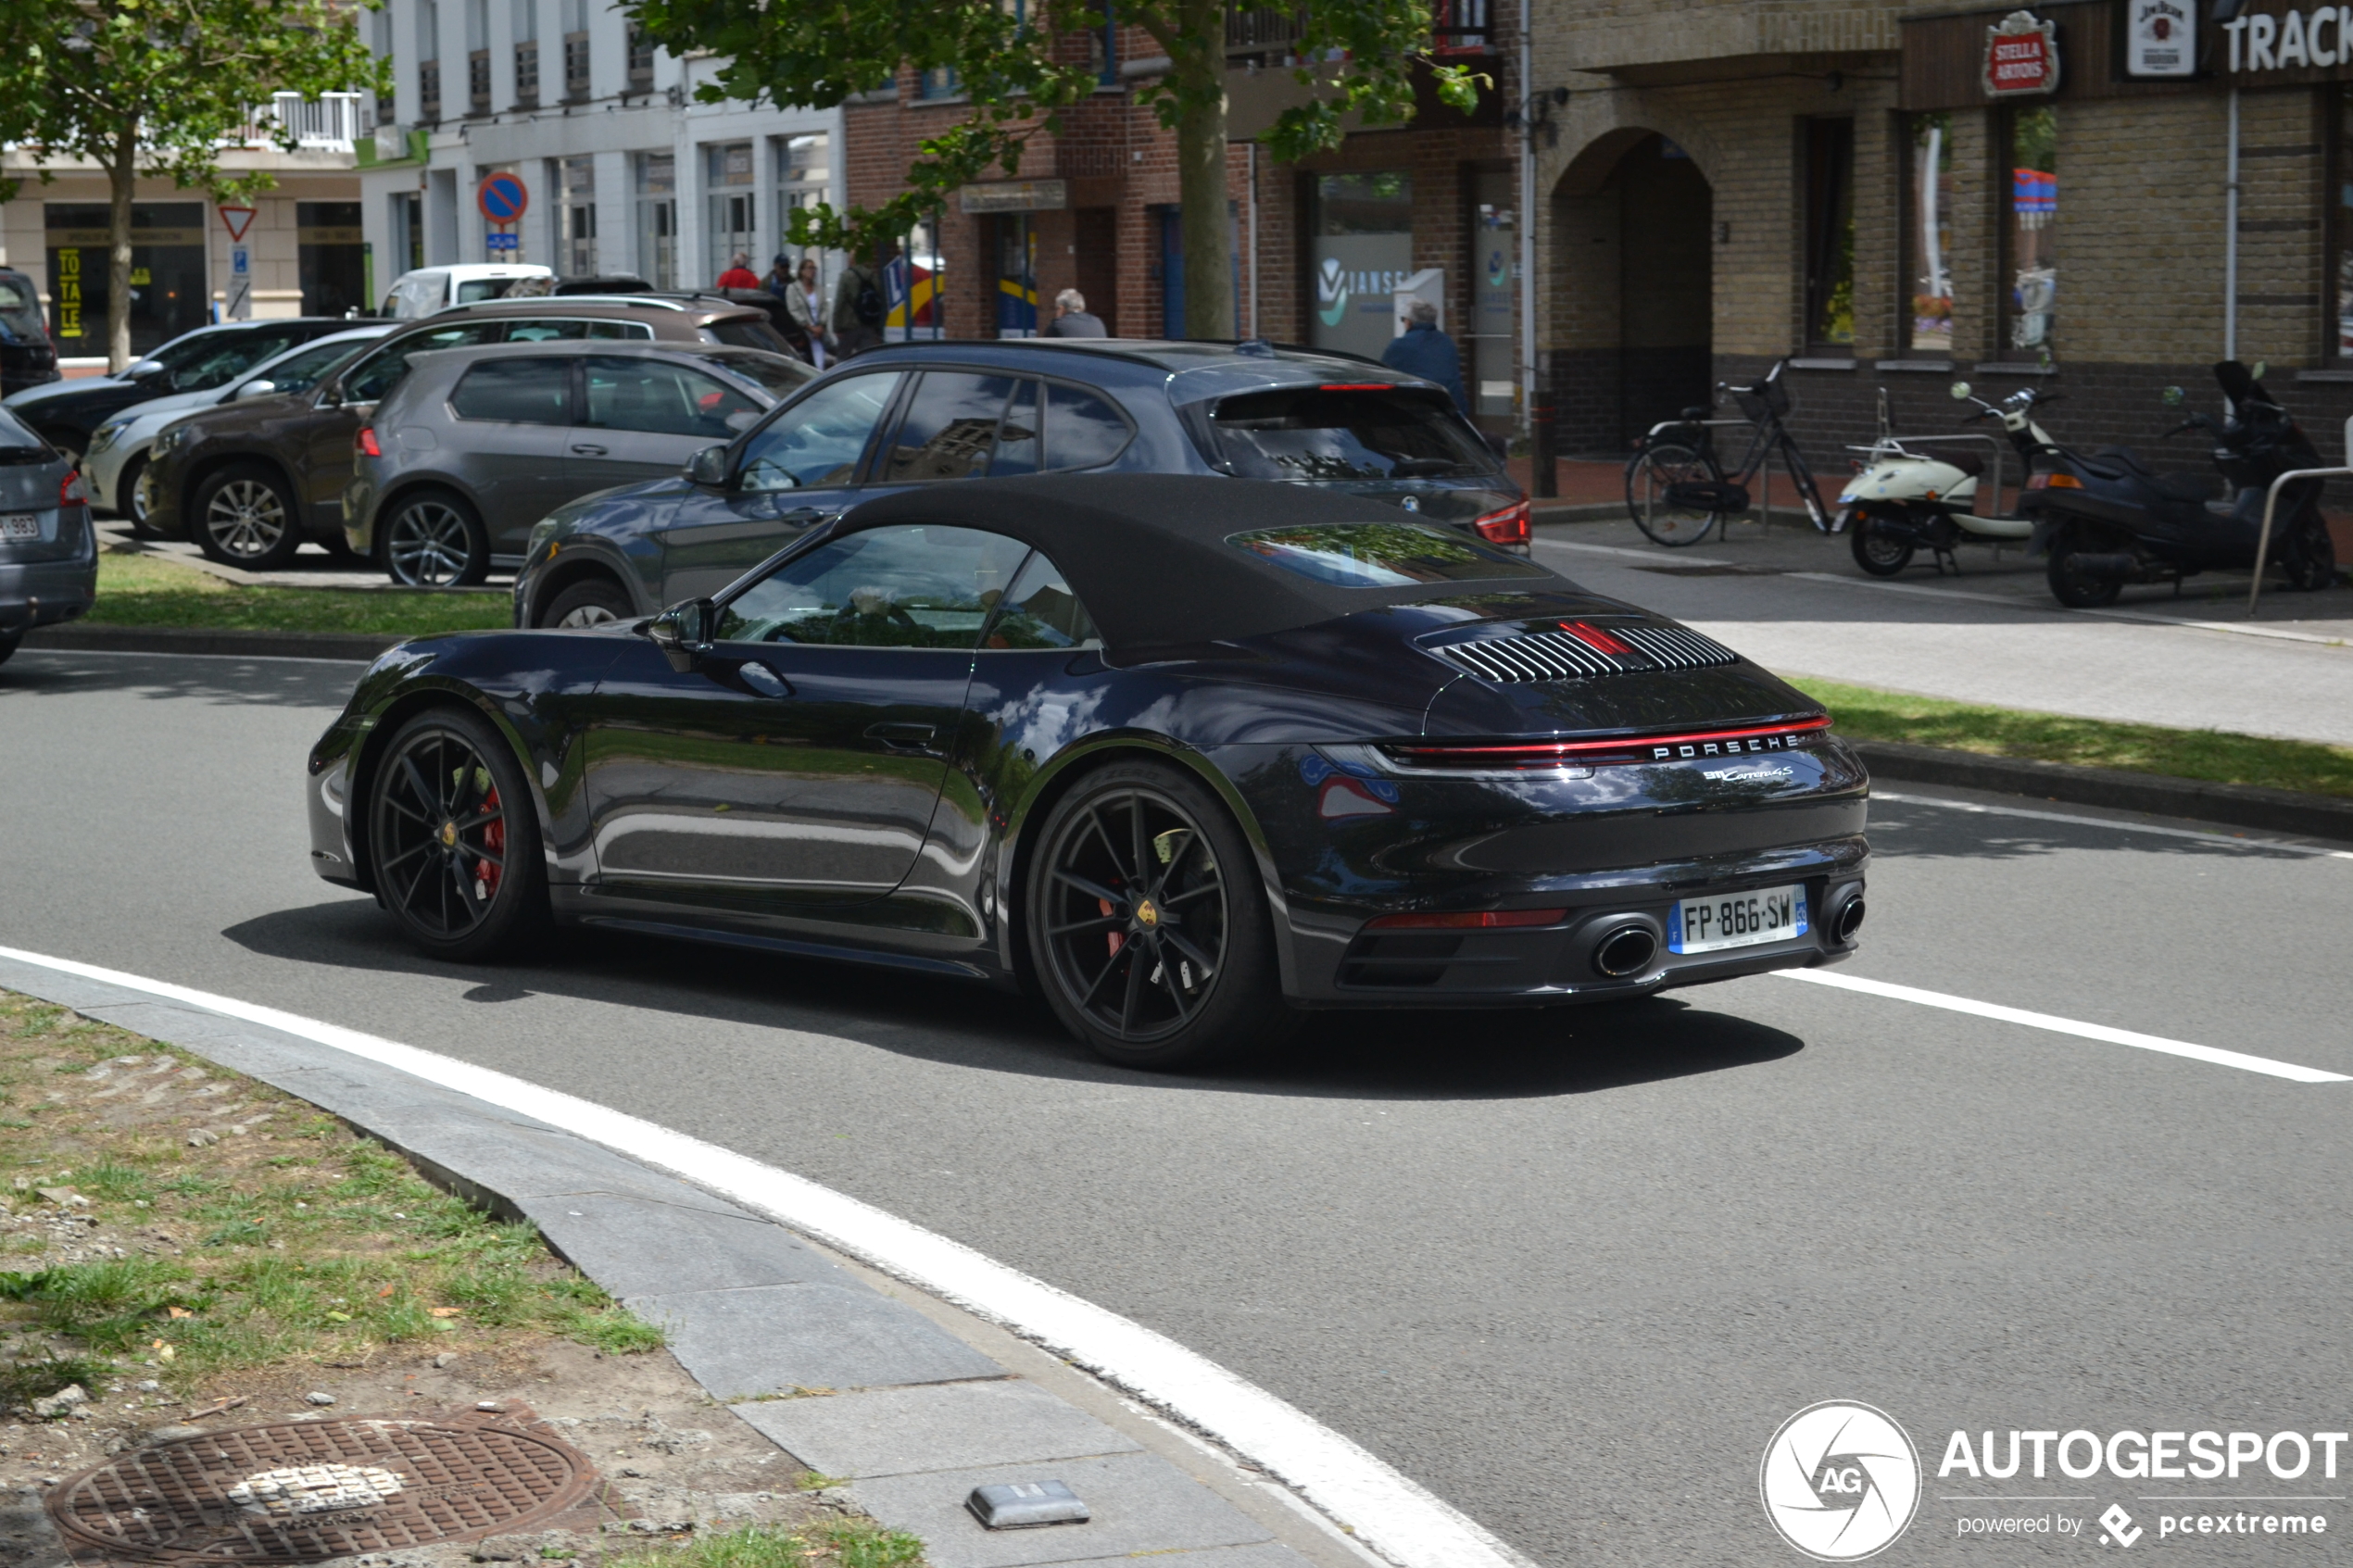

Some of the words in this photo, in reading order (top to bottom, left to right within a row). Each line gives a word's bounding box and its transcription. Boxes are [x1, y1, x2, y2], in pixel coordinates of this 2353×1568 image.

[1994, 42, 2042, 61] STELLA
[1995, 61, 2044, 81] ARTOIS
[1653, 734, 1799, 760] PORSCHE
